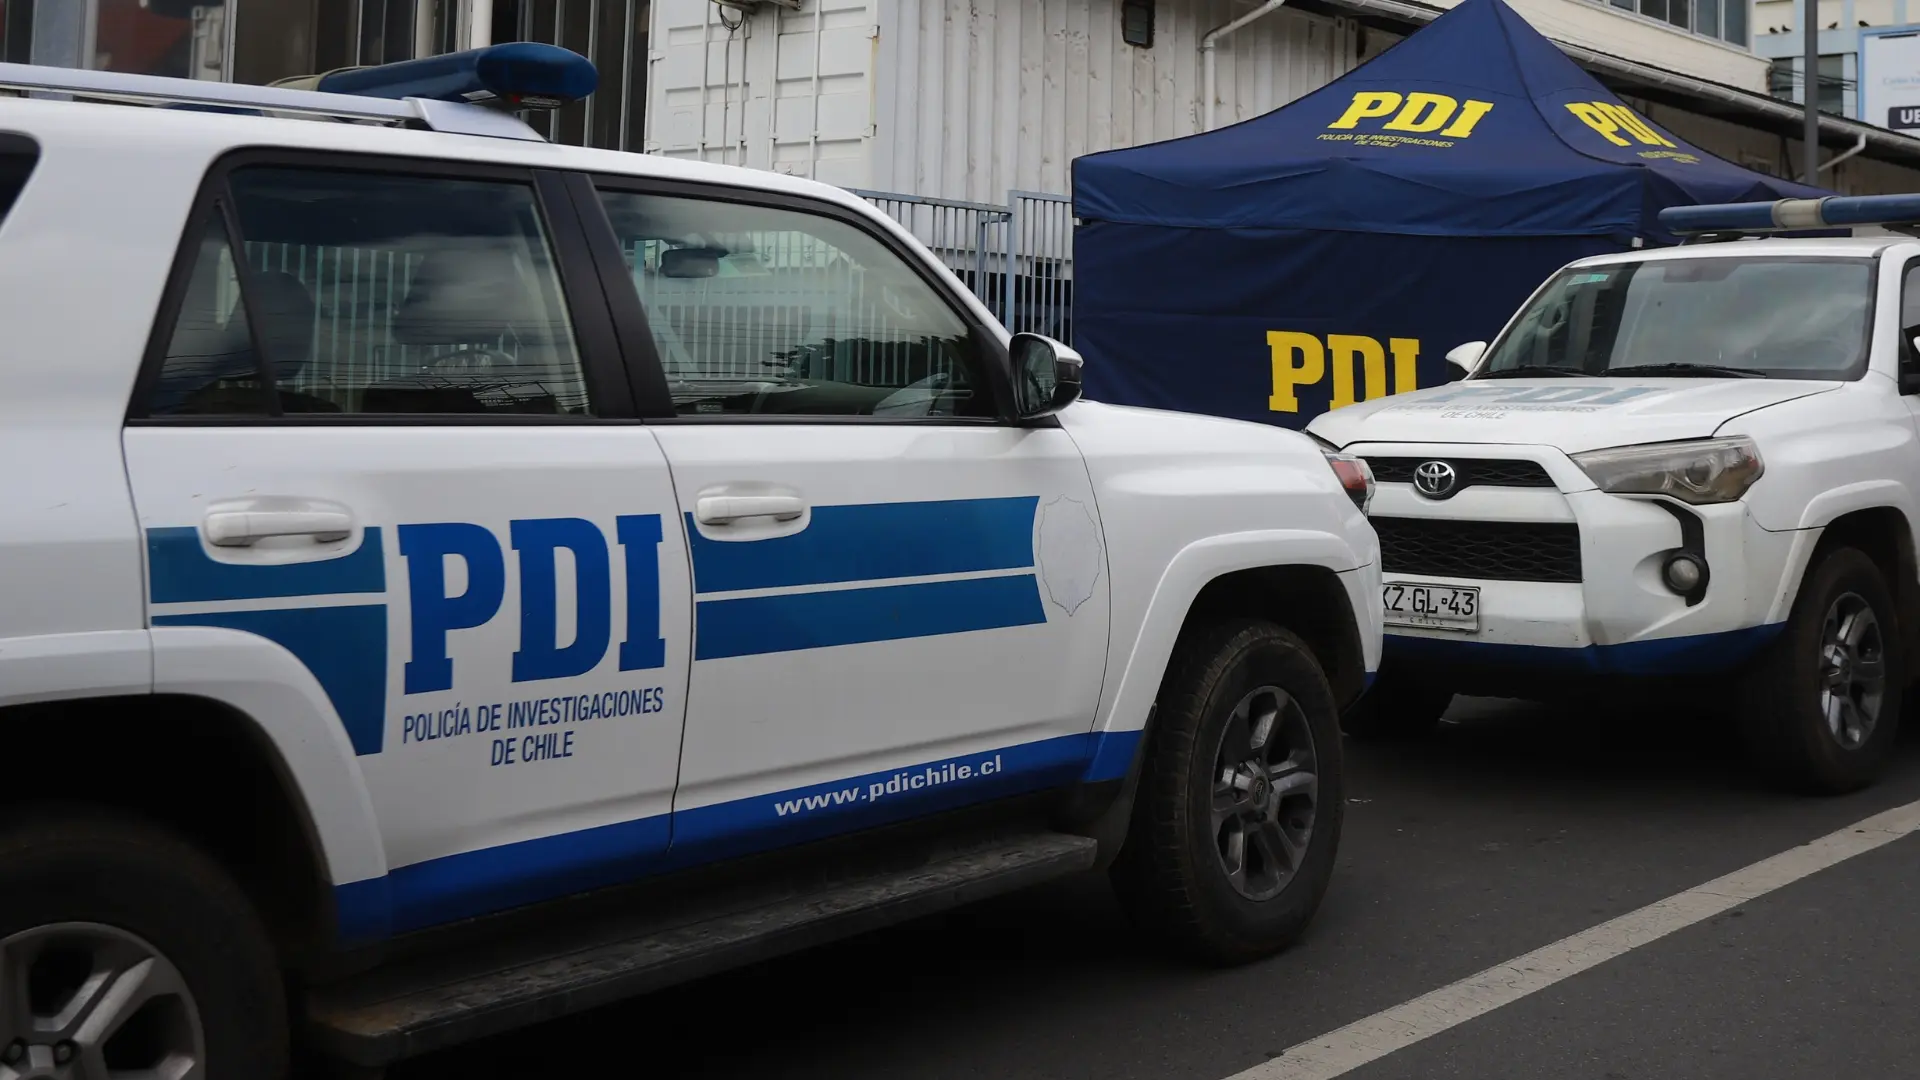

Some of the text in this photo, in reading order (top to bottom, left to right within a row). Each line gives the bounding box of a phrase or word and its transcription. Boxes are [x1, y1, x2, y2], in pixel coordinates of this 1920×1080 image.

[1327, 91, 1495, 138] PDI
[1563, 101, 1678, 149] PDI
[1316, 133, 1353, 141] POLICÍA
[1368, 134, 1454, 148] INVESTIGACIONES
[1369, 140, 1400, 148] CHILE
[1266, 330, 1420, 413] PDI
[1412, 386, 1672, 406] PDI
[397, 513, 666, 695] PDI
[403, 687, 664, 744] POLICÍA DE INVESTIGACIONES
[490, 730, 575, 766] DE CHILE
[774, 754, 1003, 817] www.pdichile.cl
